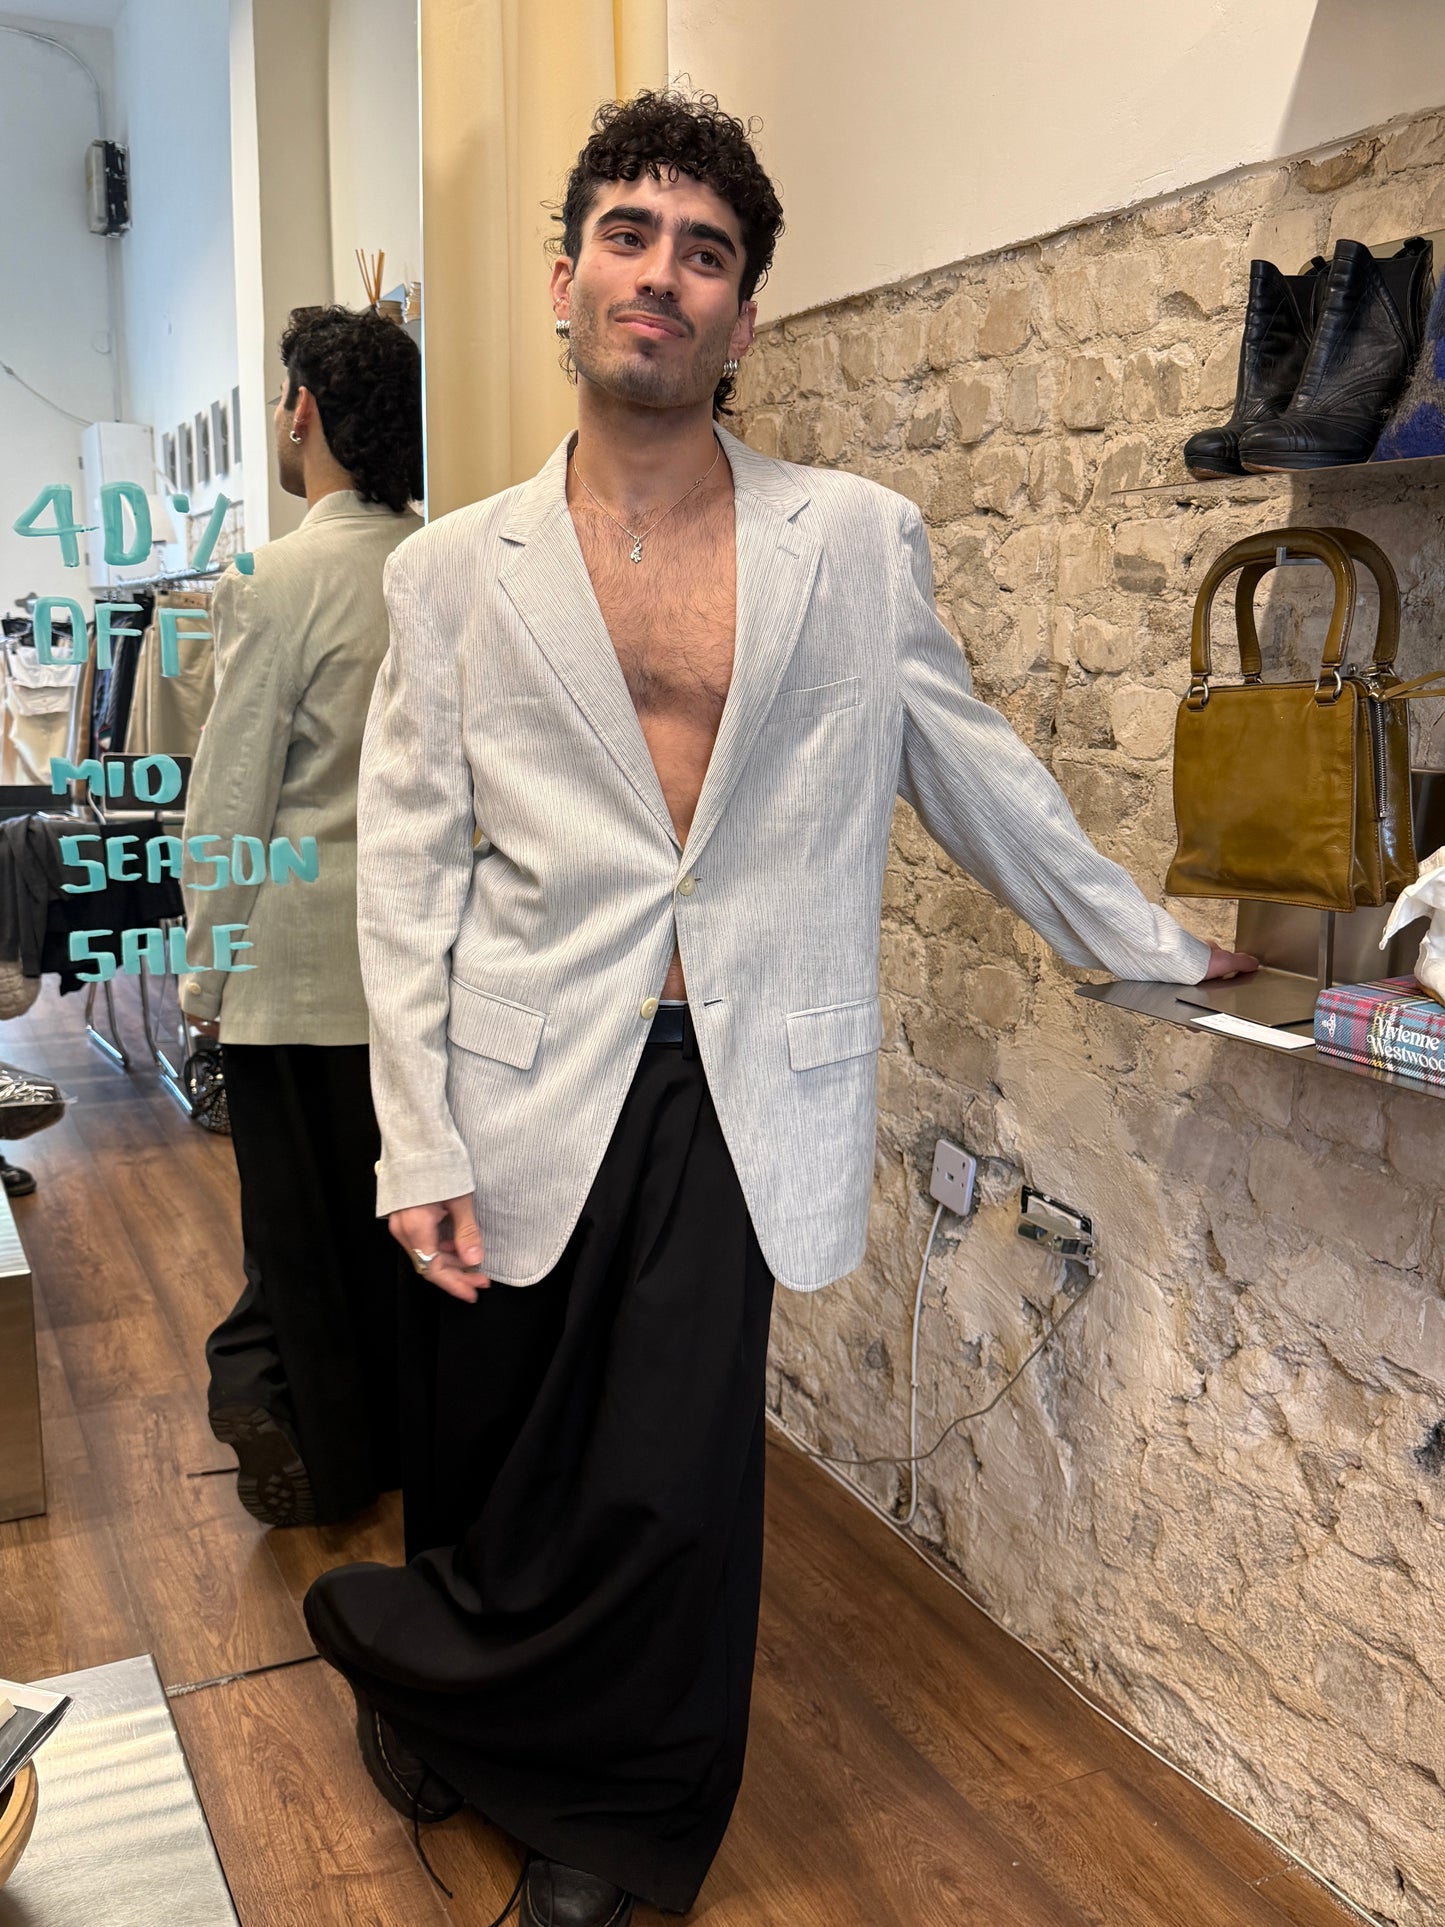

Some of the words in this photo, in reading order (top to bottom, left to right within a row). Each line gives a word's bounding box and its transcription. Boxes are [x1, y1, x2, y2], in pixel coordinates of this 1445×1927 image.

[13, 481, 256, 576] 40%
[33, 595, 214, 678] OFF
[50, 754, 183, 804] MID
[58, 834, 320, 893] SEASON
[68, 923, 258, 983] SALE
[1374, 1016, 1440, 1051] Vivienne
